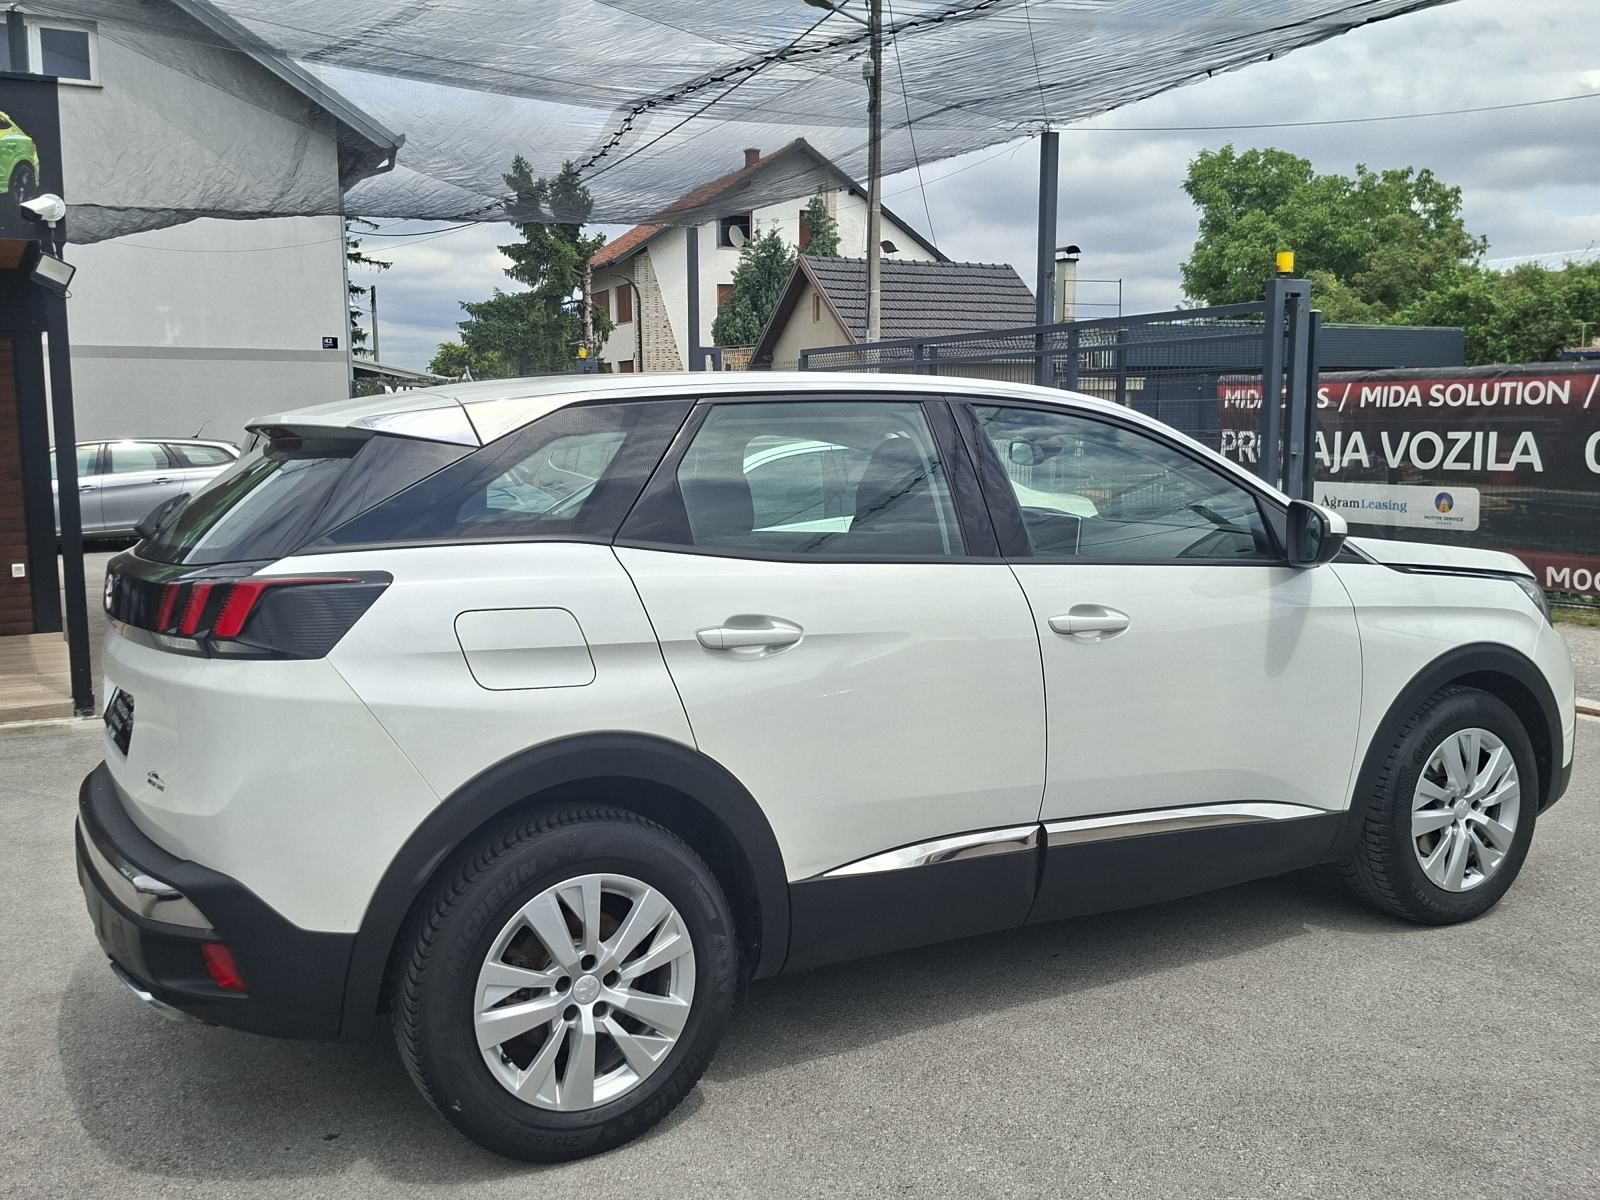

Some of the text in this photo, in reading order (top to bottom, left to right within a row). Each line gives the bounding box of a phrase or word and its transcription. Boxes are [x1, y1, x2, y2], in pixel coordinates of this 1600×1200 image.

[1224, 389, 1263, 409] MID
[1360, 384, 1422, 409] MIDA
[1428, 379, 1572, 408] SOLUTION
[1220, 429, 1370, 474] PRAJA
[1380, 430, 1544, 472] VOZILA
